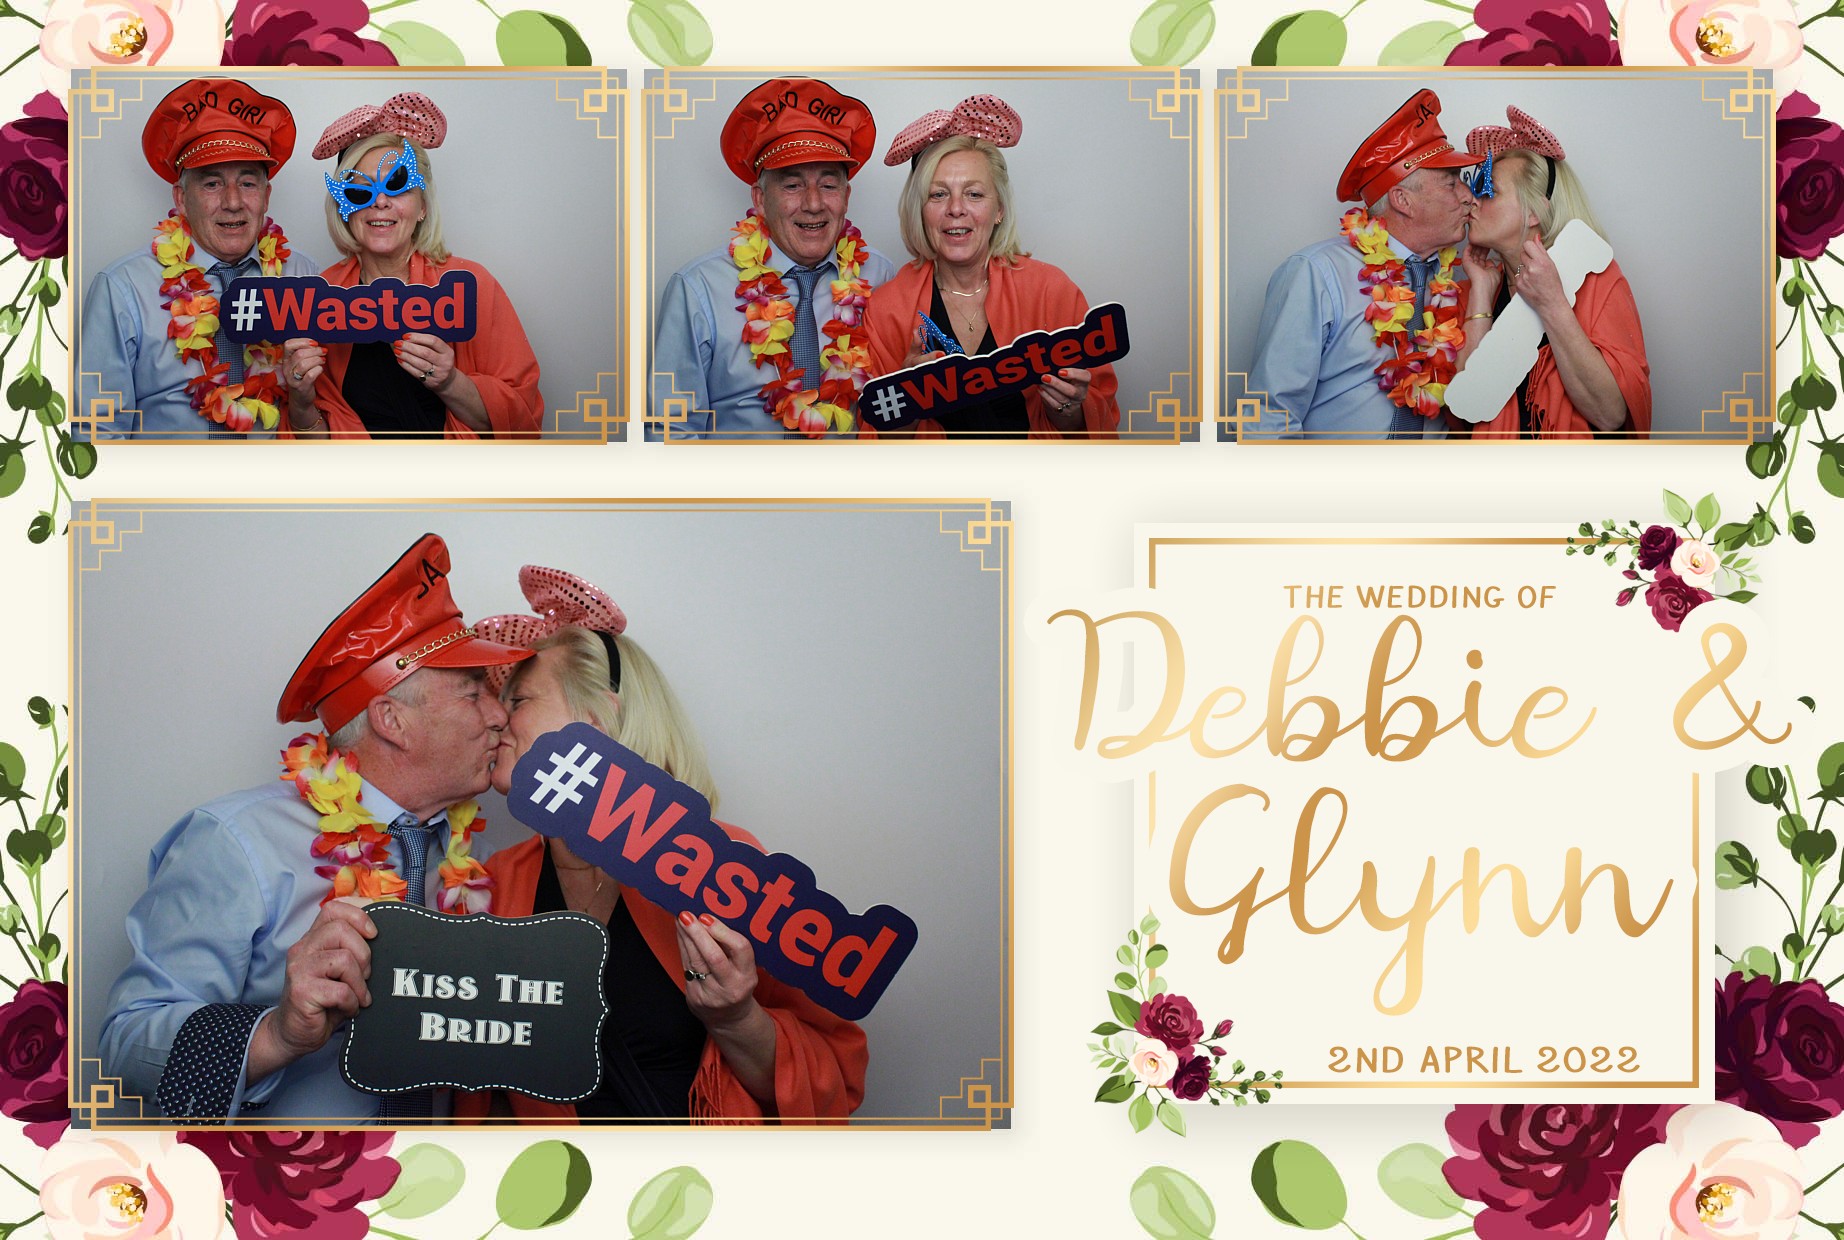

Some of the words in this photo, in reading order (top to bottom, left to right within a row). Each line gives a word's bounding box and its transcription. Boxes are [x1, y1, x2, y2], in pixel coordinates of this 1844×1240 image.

[182, 91, 218, 122] BAD
[762, 91, 798, 123] BAD
[230, 282, 465, 333] #Wasted
[871, 315, 1119, 423] #Wasted
[529, 742, 899, 999] #Wasted
